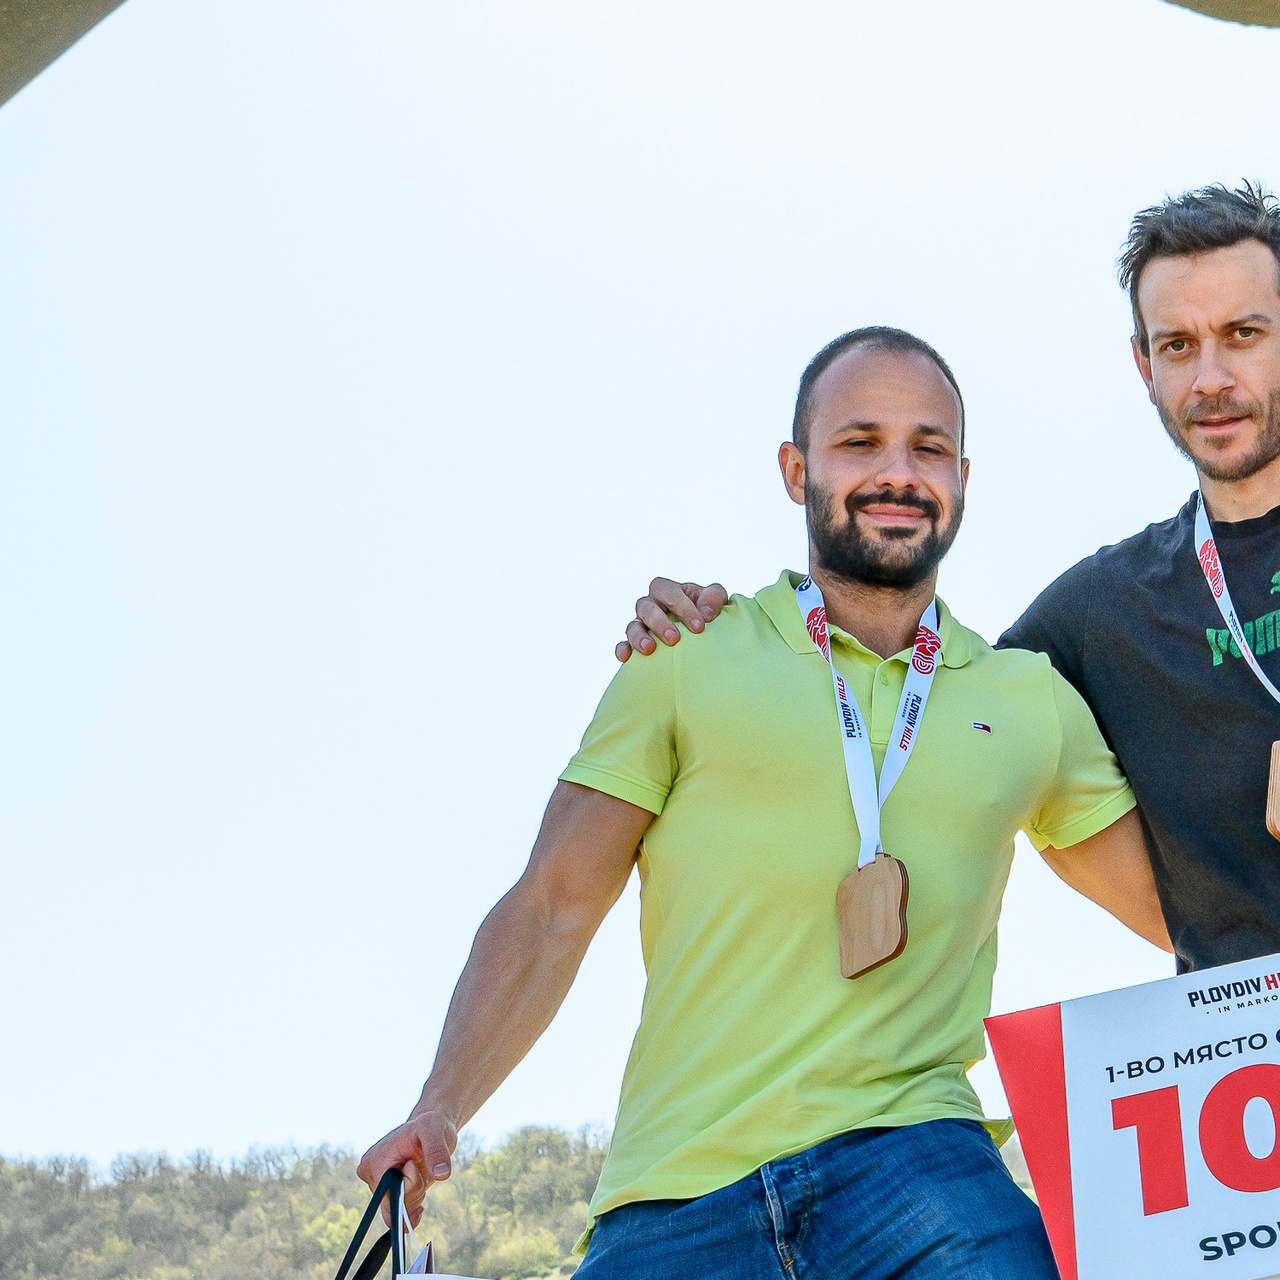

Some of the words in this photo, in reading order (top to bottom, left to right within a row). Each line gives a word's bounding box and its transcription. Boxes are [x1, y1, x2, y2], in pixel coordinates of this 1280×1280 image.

[836, 676, 848, 702] HILLS
[840, 702, 857, 738] PLOVDIV
[906, 693, 923, 729] PLOVDIV
[899, 726, 914, 752] HILLS
[1187, 977, 1261, 1007] PLOVDIV
[1218, 1005, 1231, 1013] IN
[1105, 1055, 1165, 1083] 1-ВО
[1174, 1032, 1268, 1069] МЯСТО
